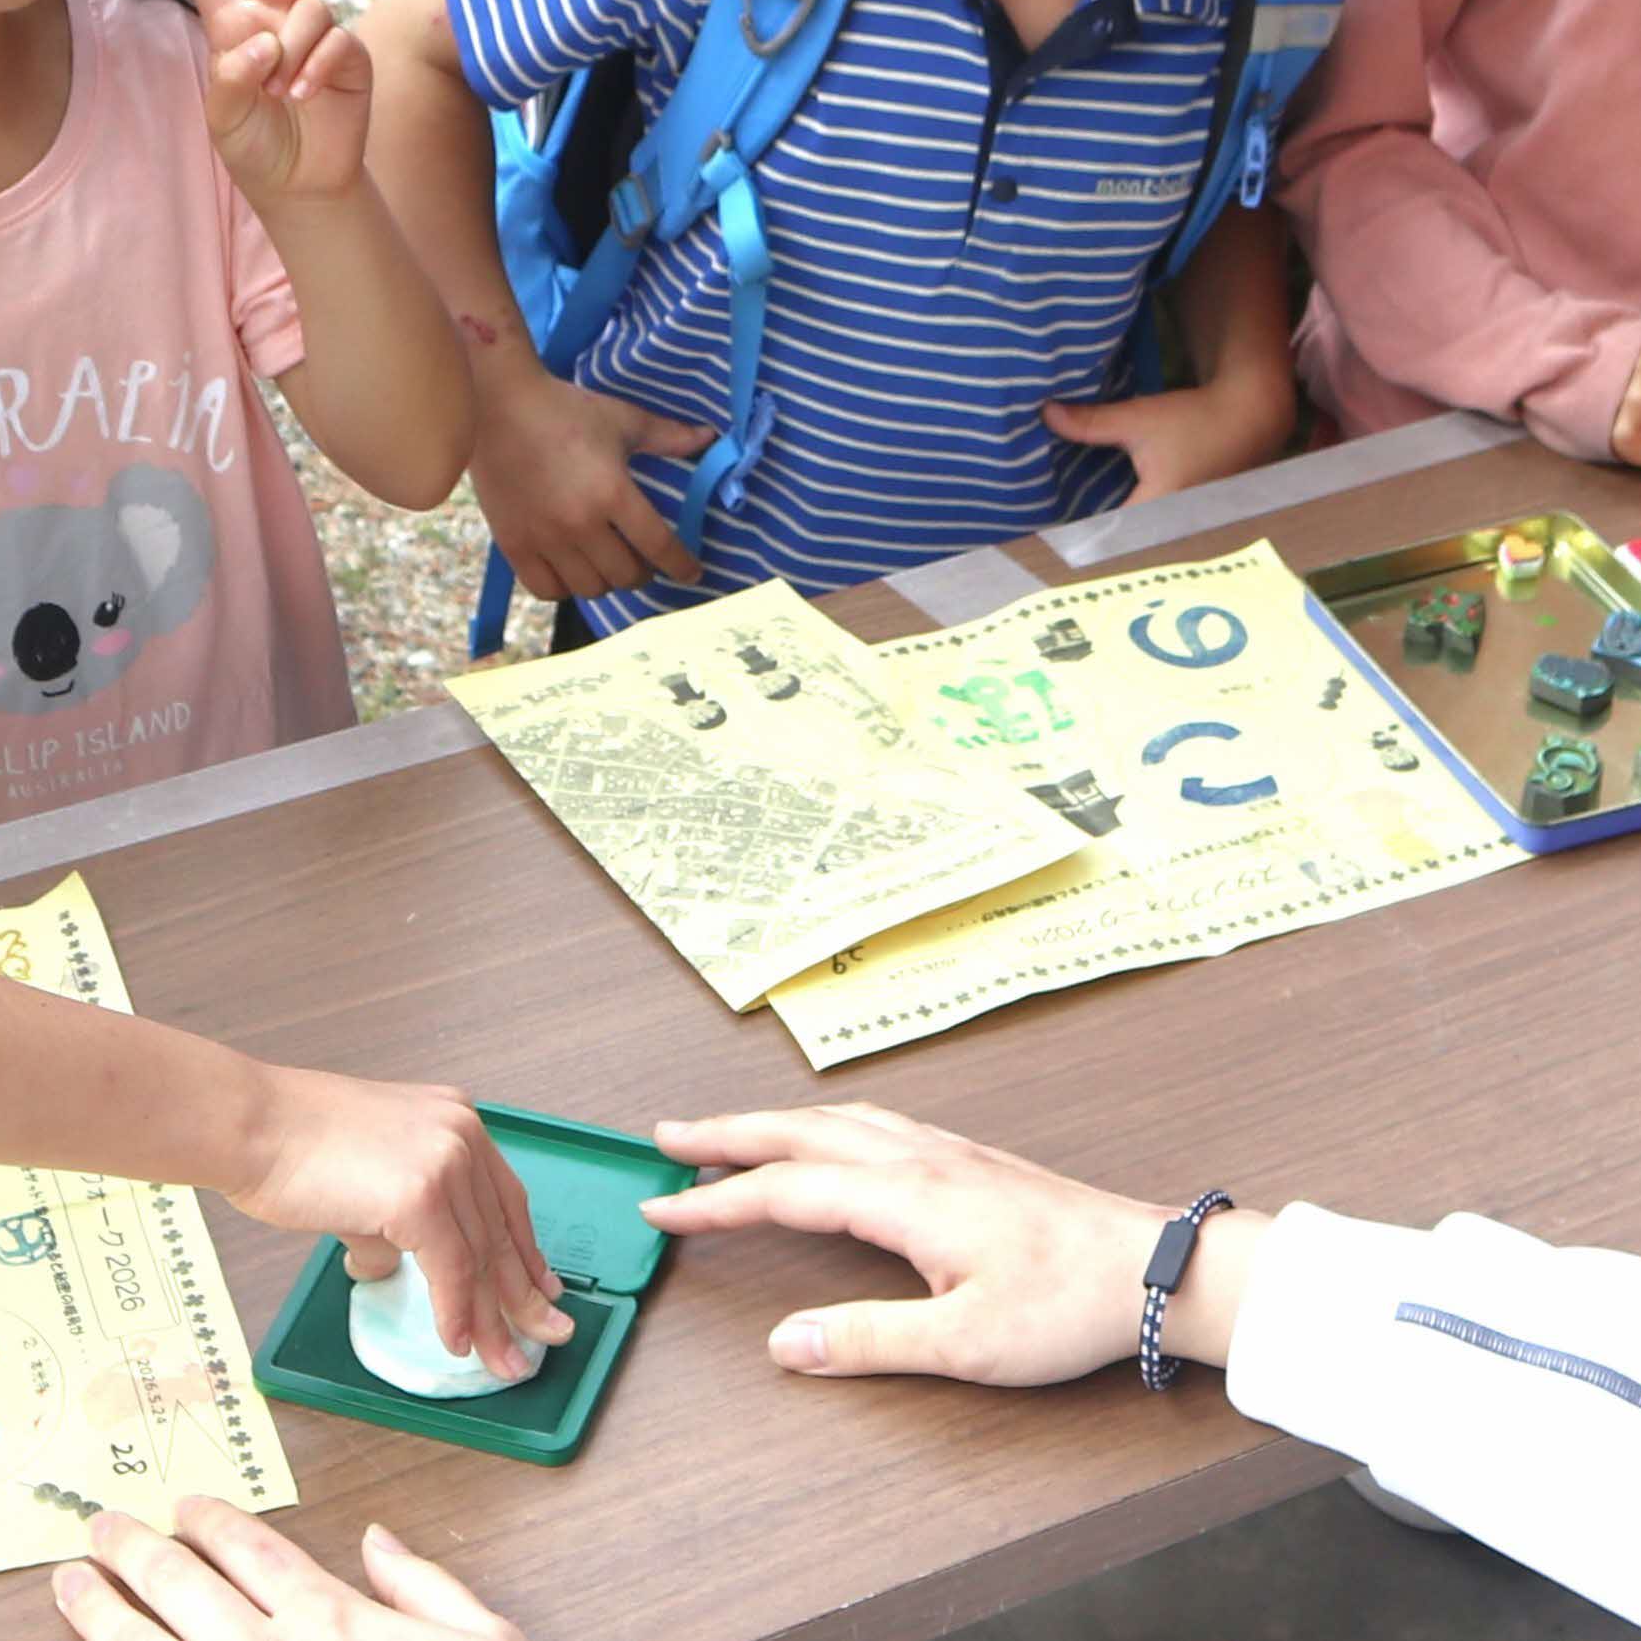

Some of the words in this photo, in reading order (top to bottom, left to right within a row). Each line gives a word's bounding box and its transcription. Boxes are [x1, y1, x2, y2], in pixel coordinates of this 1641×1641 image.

[73, 702, 193, 757] ISLAND
[136, 1359, 168, 1424] 2026.5.24
[110, 1443, 148, 1476] 28
